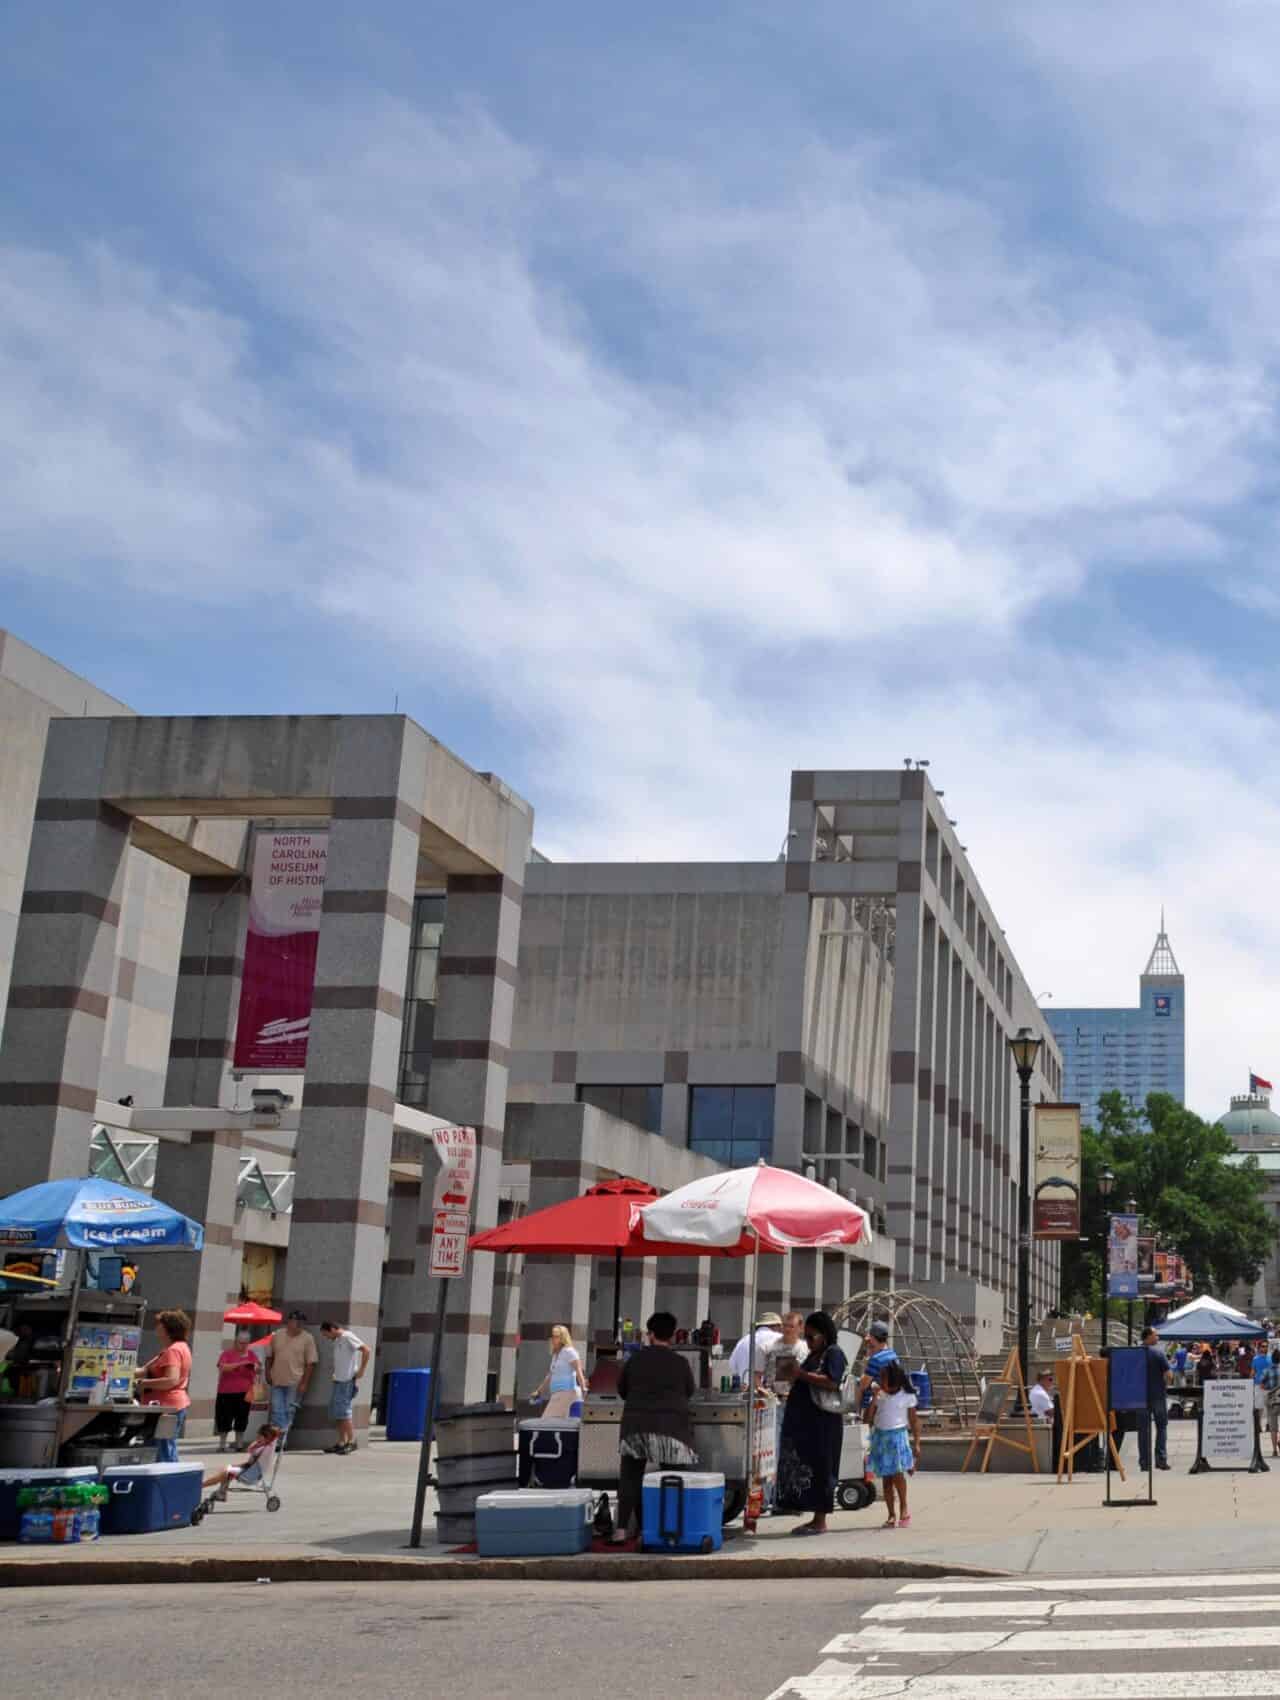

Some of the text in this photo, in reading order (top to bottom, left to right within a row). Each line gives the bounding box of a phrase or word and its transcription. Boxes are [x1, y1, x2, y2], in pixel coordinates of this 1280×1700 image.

[273, 836, 311, 847] NORTH
[271, 849, 327, 859] CAROLINA
[271, 862, 319, 873] MUSEUM
[270, 875, 325, 886] OF HISTOR
[435, 1131, 449, 1145] NO
[83, 1226, 167, 1241] Ice Cream
[439, 1237, 460, 1249] ANY
[437, 1251, 460, 1264] TIME
